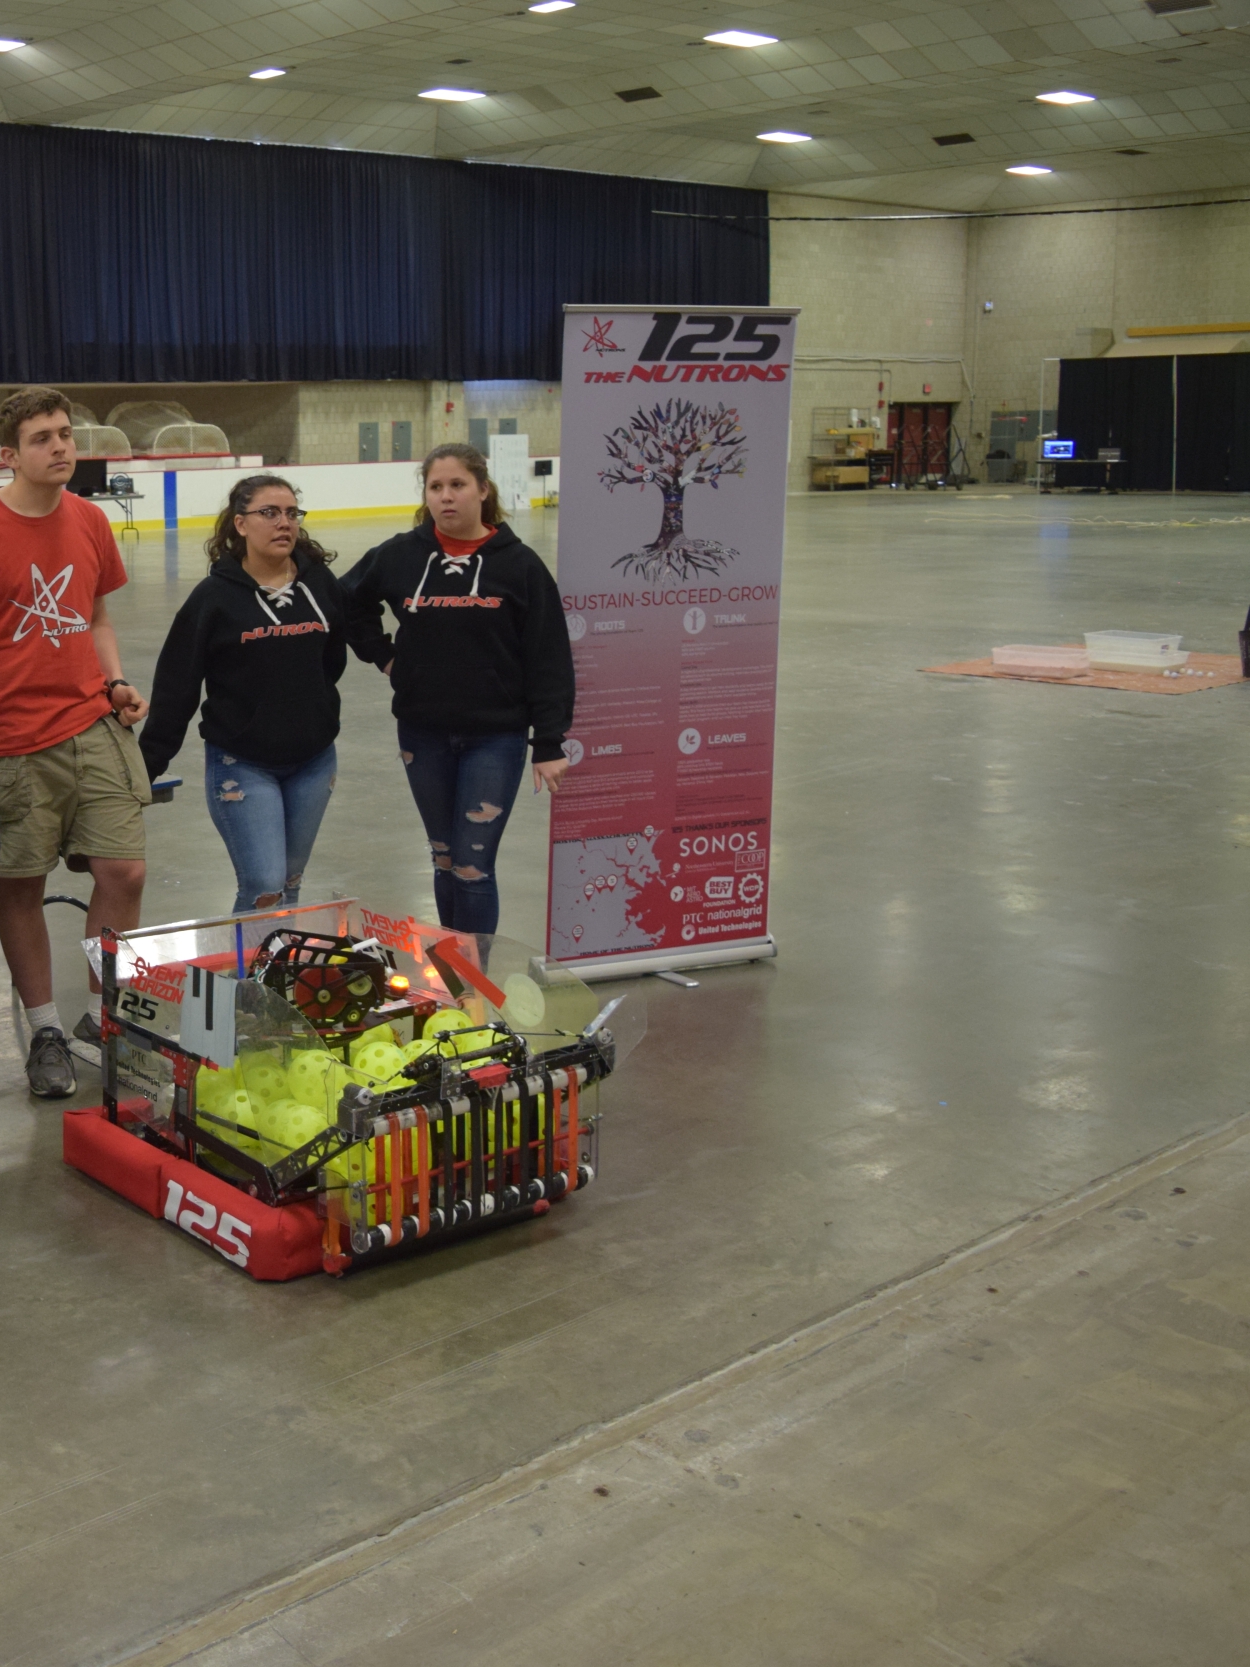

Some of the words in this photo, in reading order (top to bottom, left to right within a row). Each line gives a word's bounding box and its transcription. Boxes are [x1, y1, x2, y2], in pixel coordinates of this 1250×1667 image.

[638, 312, 792, 362] 125
[584, 372, 626, 384] THE
[626, 364, 791, 384] NUTRONS
[403, 596, 503, 609] NUTRONS
[594, 620, 626, 631] ROOTS
[714, 614, 747, 624] TRUNK
[241, 621, 329, 644] NUTRON
[708, 733, 747, 745] LEAVES
[592, 744, 623, 756] LIMBS
[672, 826, 683, 834] 125
[686, 823, 714, 833] THANKS
[731, 818, 767, 828] SPONSORS
[680, 831, 758, 857] SONOS
[742, 852, 765, 864] COOP
[709, 880, 733, 888] BEST
[703, 898, 736, 908] FOUNDATION
[708, 904, 763, 921] nationalgrid
[698, 924, 720, 935] United
[721, 920, 762, 932] Technologies
[129, 974, 186, 1005] HORIZON
[132, 1049, 147, 1064] PTC
[130, 1064, 161, 1088] Technologies
[162, 1178, 252, 1268] 125
